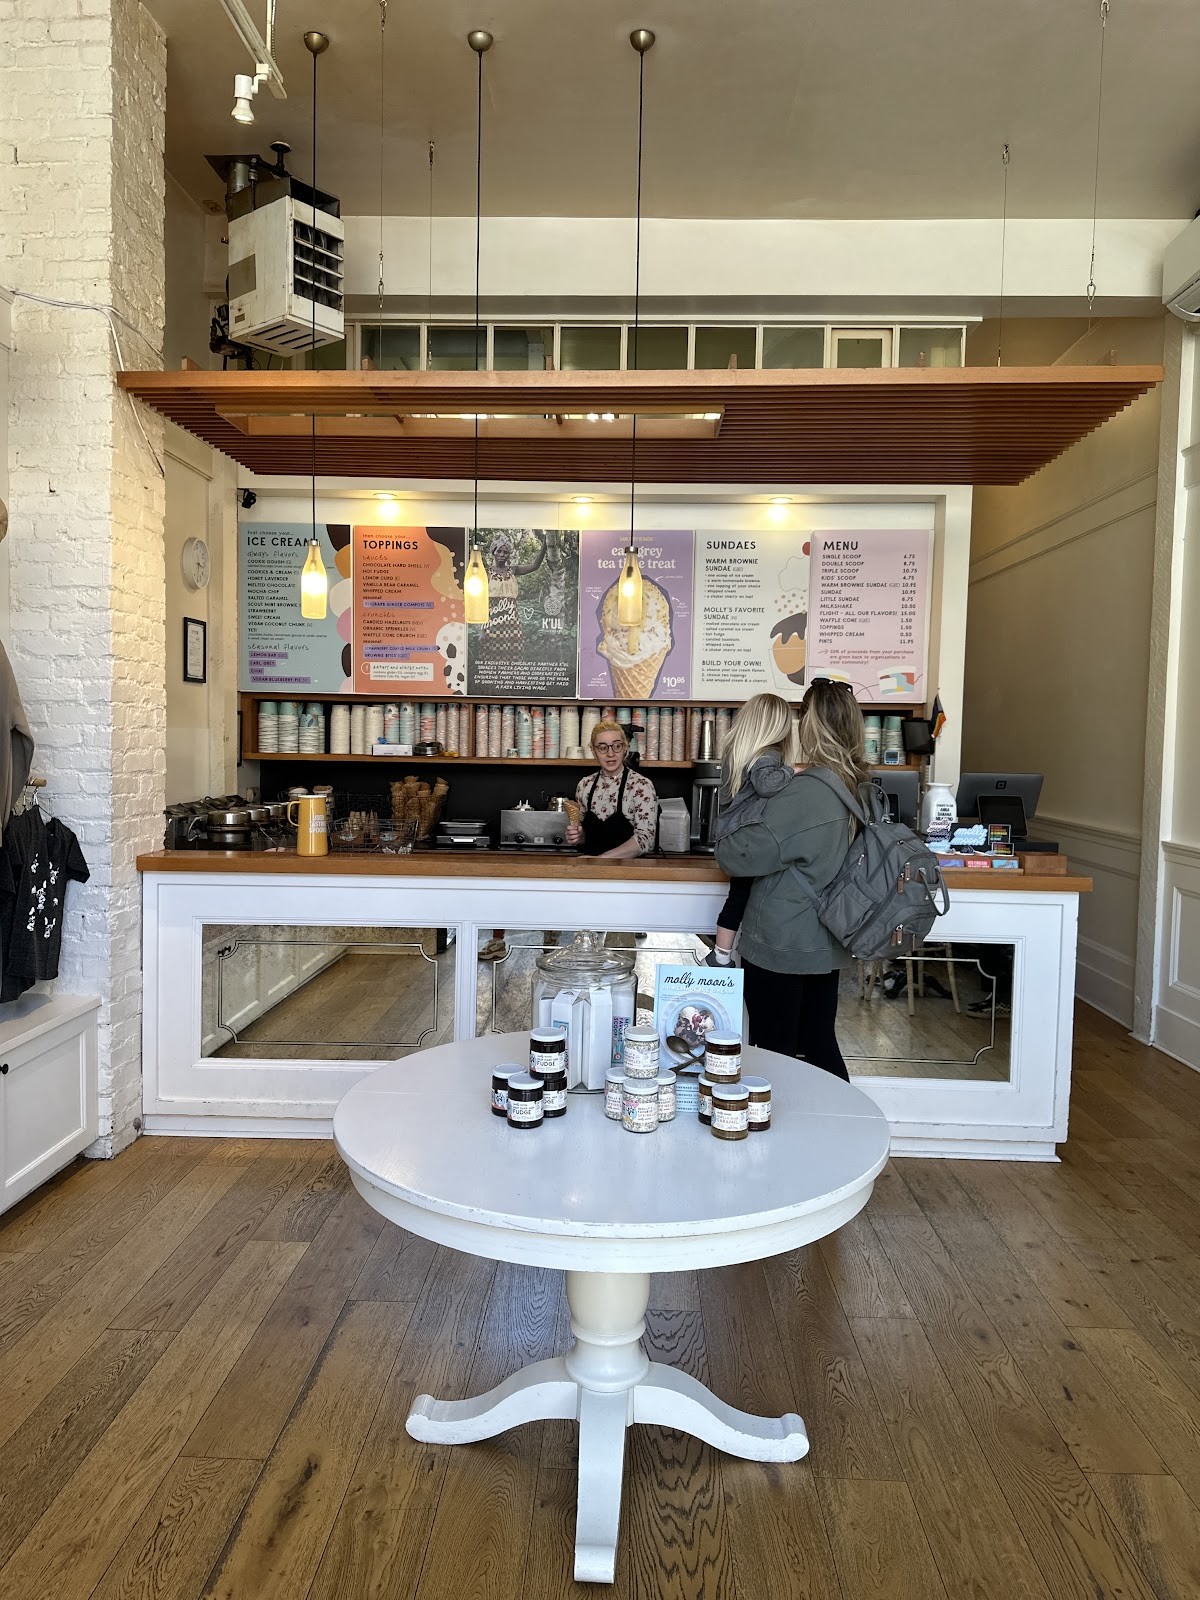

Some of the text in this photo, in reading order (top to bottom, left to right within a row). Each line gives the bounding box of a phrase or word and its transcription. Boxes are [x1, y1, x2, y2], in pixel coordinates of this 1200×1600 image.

[248, 537, 266, 546] ICE
[364, 541, 418, 549] TOPPINGS
[706, 541, 756, 550] SUNDAES
[823, 541, 858, 550] MENU
[638, 546, 662, 559] grey
[598, 558, 676, 568] tea tie treat
[489, 598, 515, 615] olly
[542, 618, 563, 629] K'UL
[664, 972, 734, 988] molly moon's
